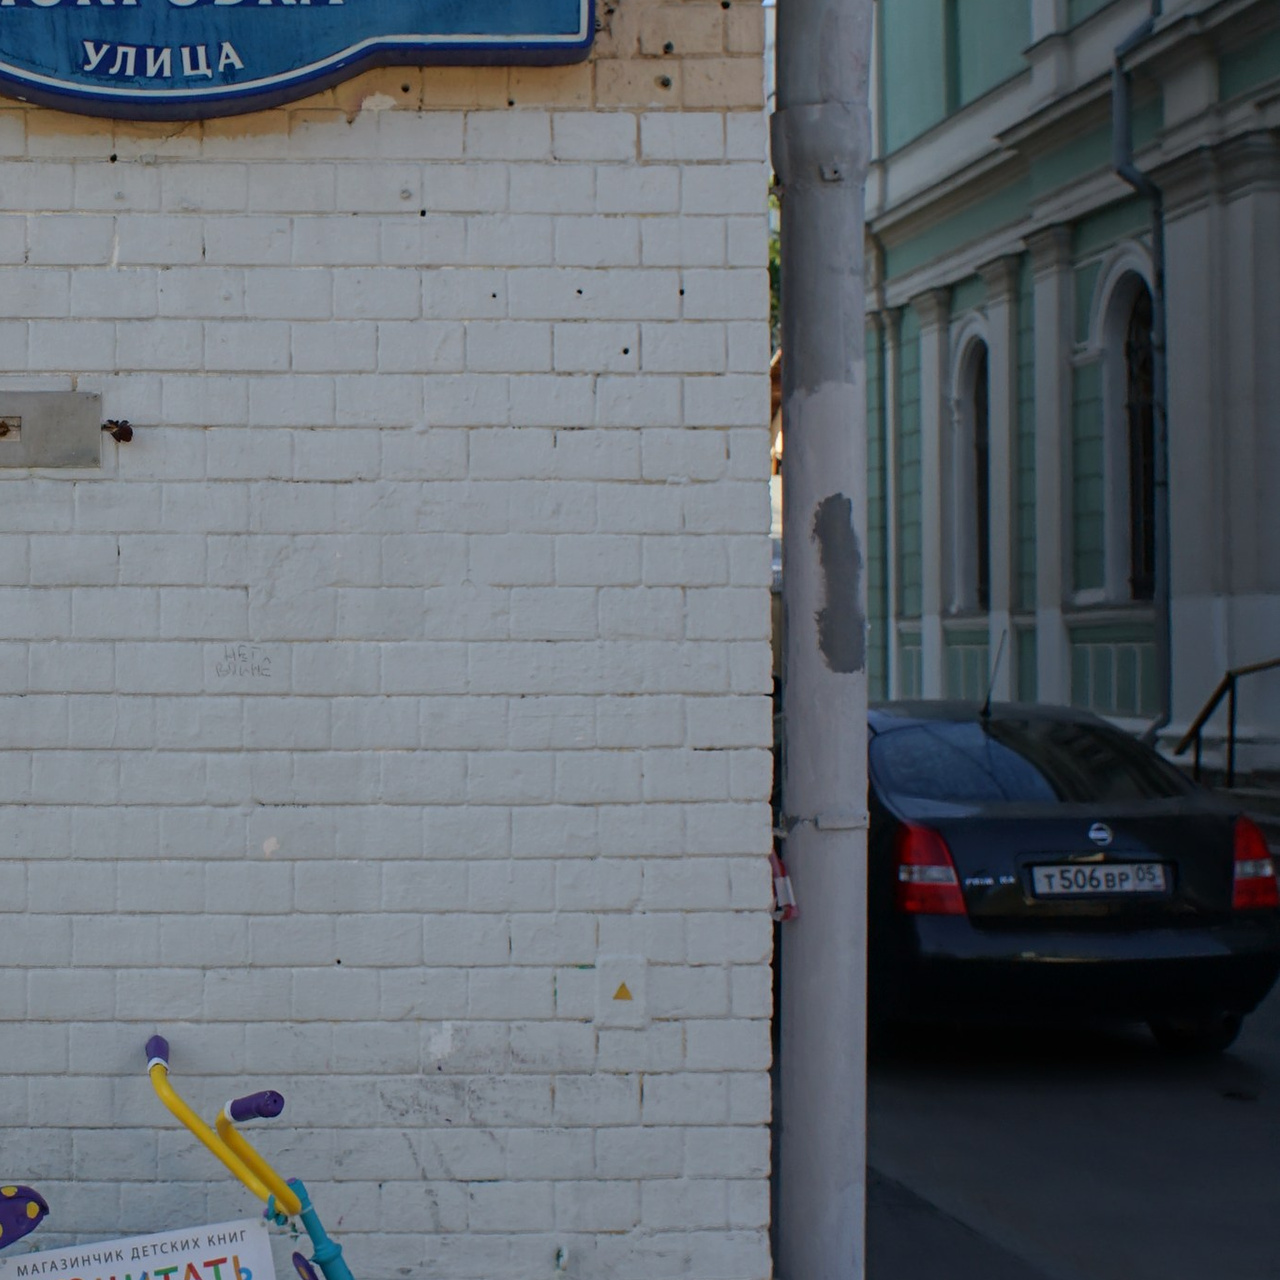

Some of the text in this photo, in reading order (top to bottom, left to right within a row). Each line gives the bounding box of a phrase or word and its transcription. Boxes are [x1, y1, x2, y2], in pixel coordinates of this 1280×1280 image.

[81, 39, 245, 79] УЛИЦА
[17, 1230, 247, 1277] МАГАЗИНЧИК ДЕТСКИХ КНИГ
